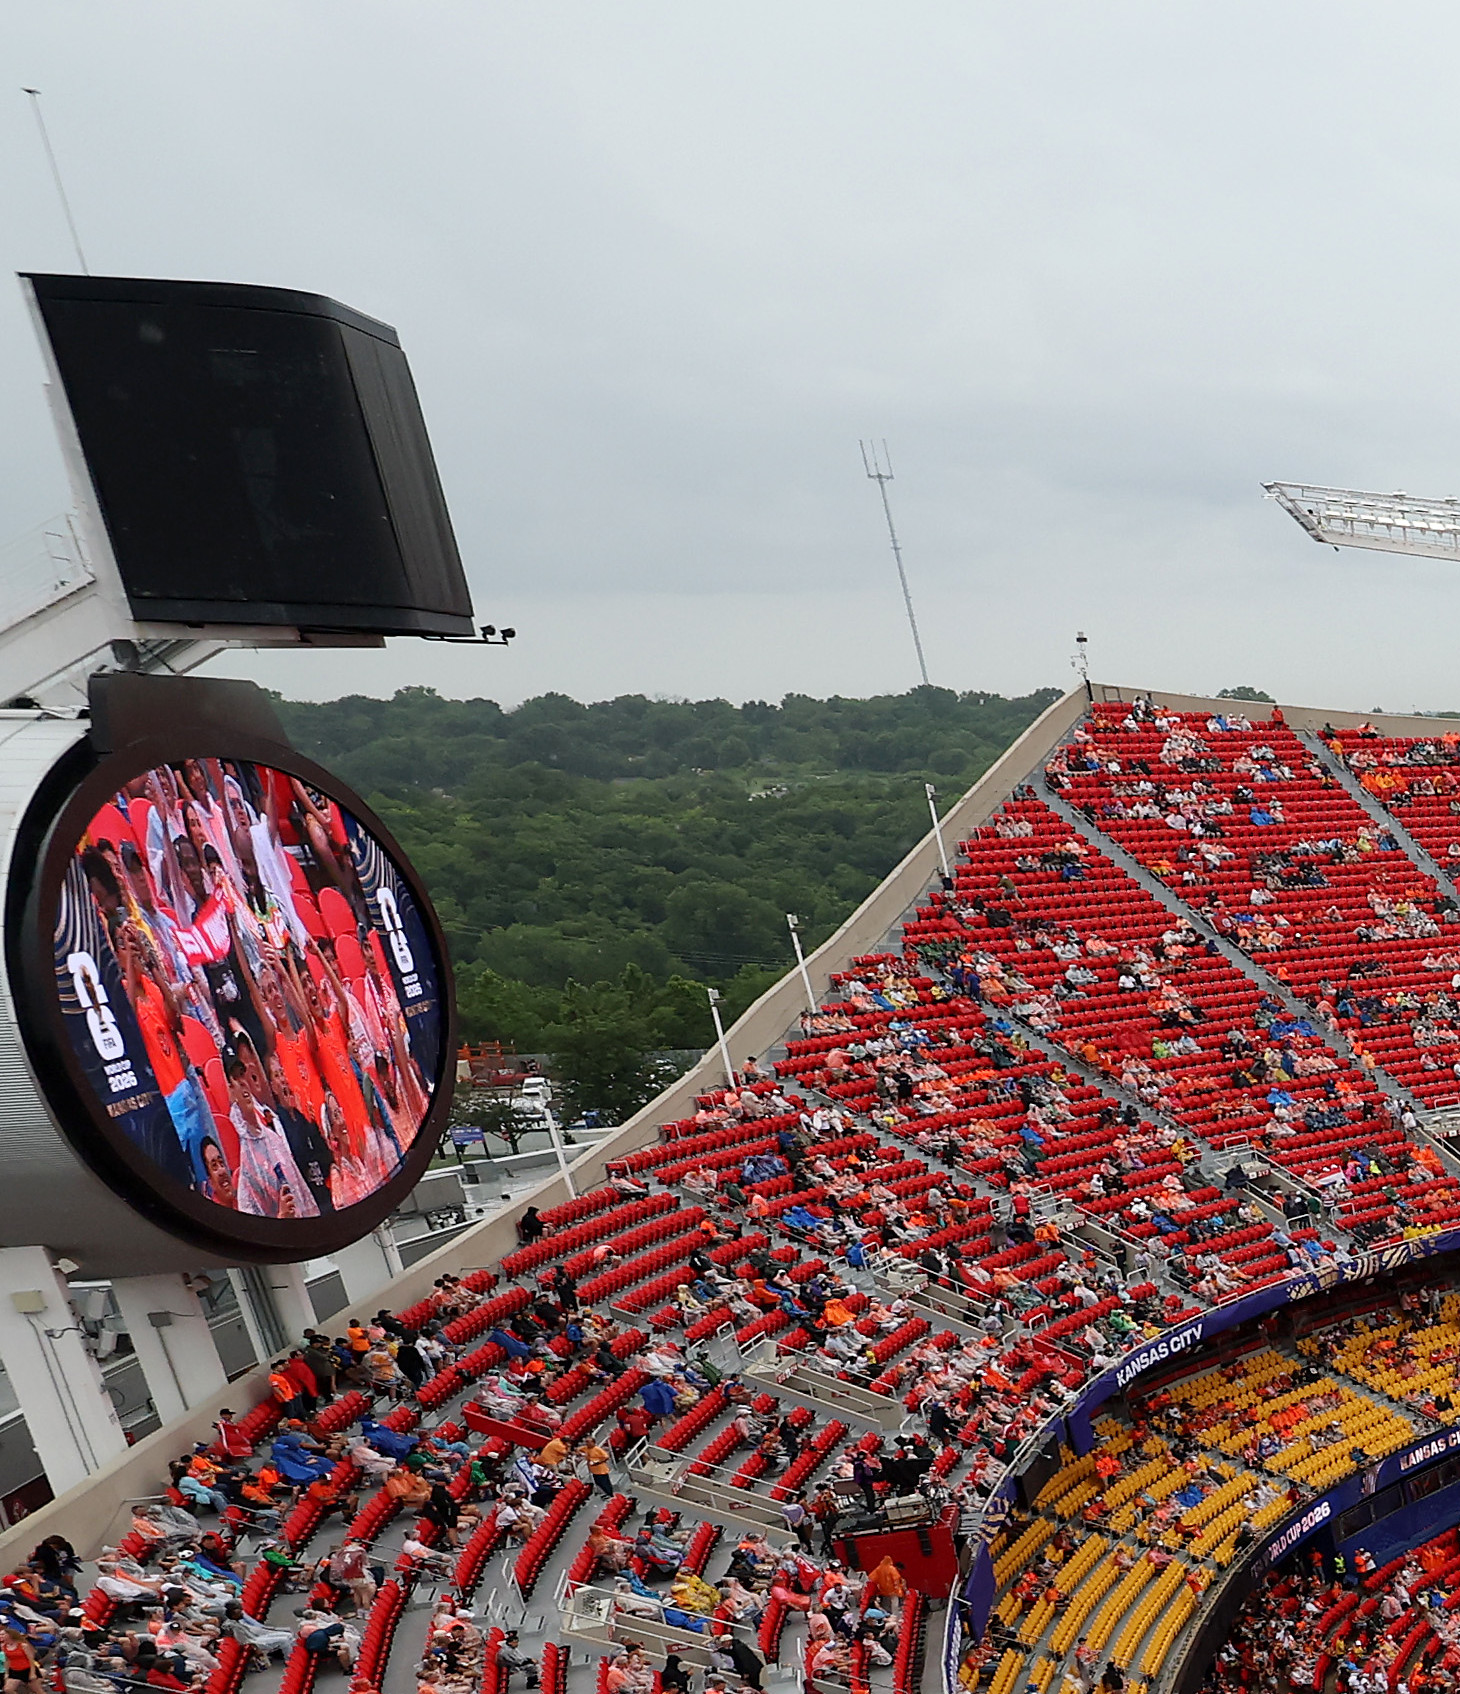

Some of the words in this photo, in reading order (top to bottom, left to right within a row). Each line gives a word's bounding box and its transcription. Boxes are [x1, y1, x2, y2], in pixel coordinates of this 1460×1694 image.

[108, 1070, 138, 1093] 2026
[1116, 1337, 1170, 1387] KANSAS
[1169, 1323, 1202, 1353] CITY
[1399, 1441, 1446, 1471] KANSAS
[1286, 1522, 1301, 1545] CUP
[1301, 1501, 1331, 1533] 2026
